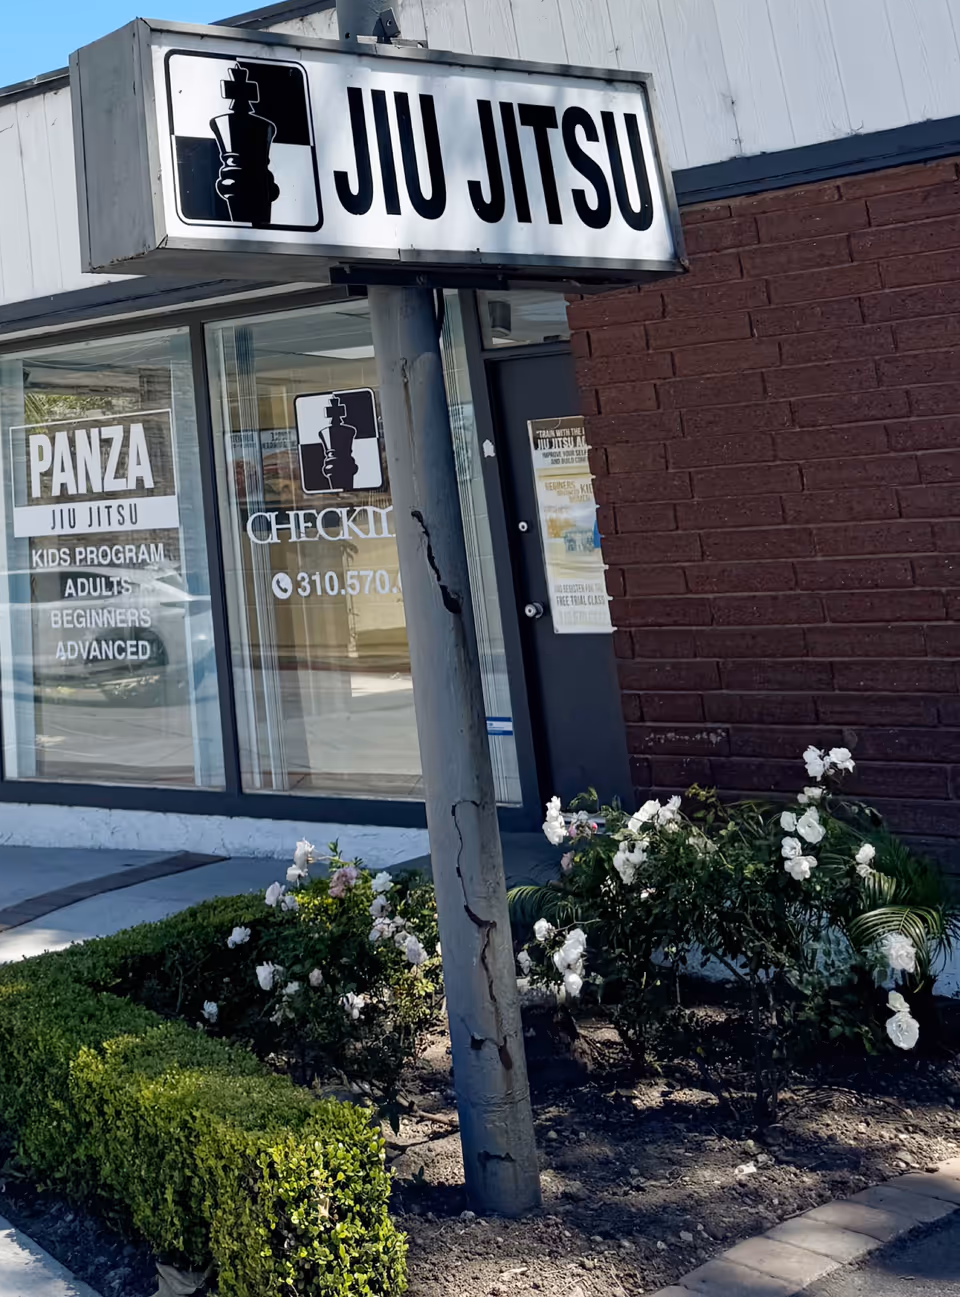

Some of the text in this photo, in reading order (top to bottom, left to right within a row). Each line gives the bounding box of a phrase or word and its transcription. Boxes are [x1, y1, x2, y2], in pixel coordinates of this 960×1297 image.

[333, 85, 655, 232] JIU JITSU
[538, 438, 550, 450] JIU
[552, 437, 574, 449] JITSU
[28, 422, 155, 499] PANZA
[49, 502, 139, 531] JIU JITSU
[31, 542, 165, 569] KIDS PROGRAM
[64, 576, 133, 598] ADULTS
[296, 569, 403, 596] 310.570.
[50, 607, 152, 629] BEGINNERS
[55, 640, 152, 661] ADVANCED
